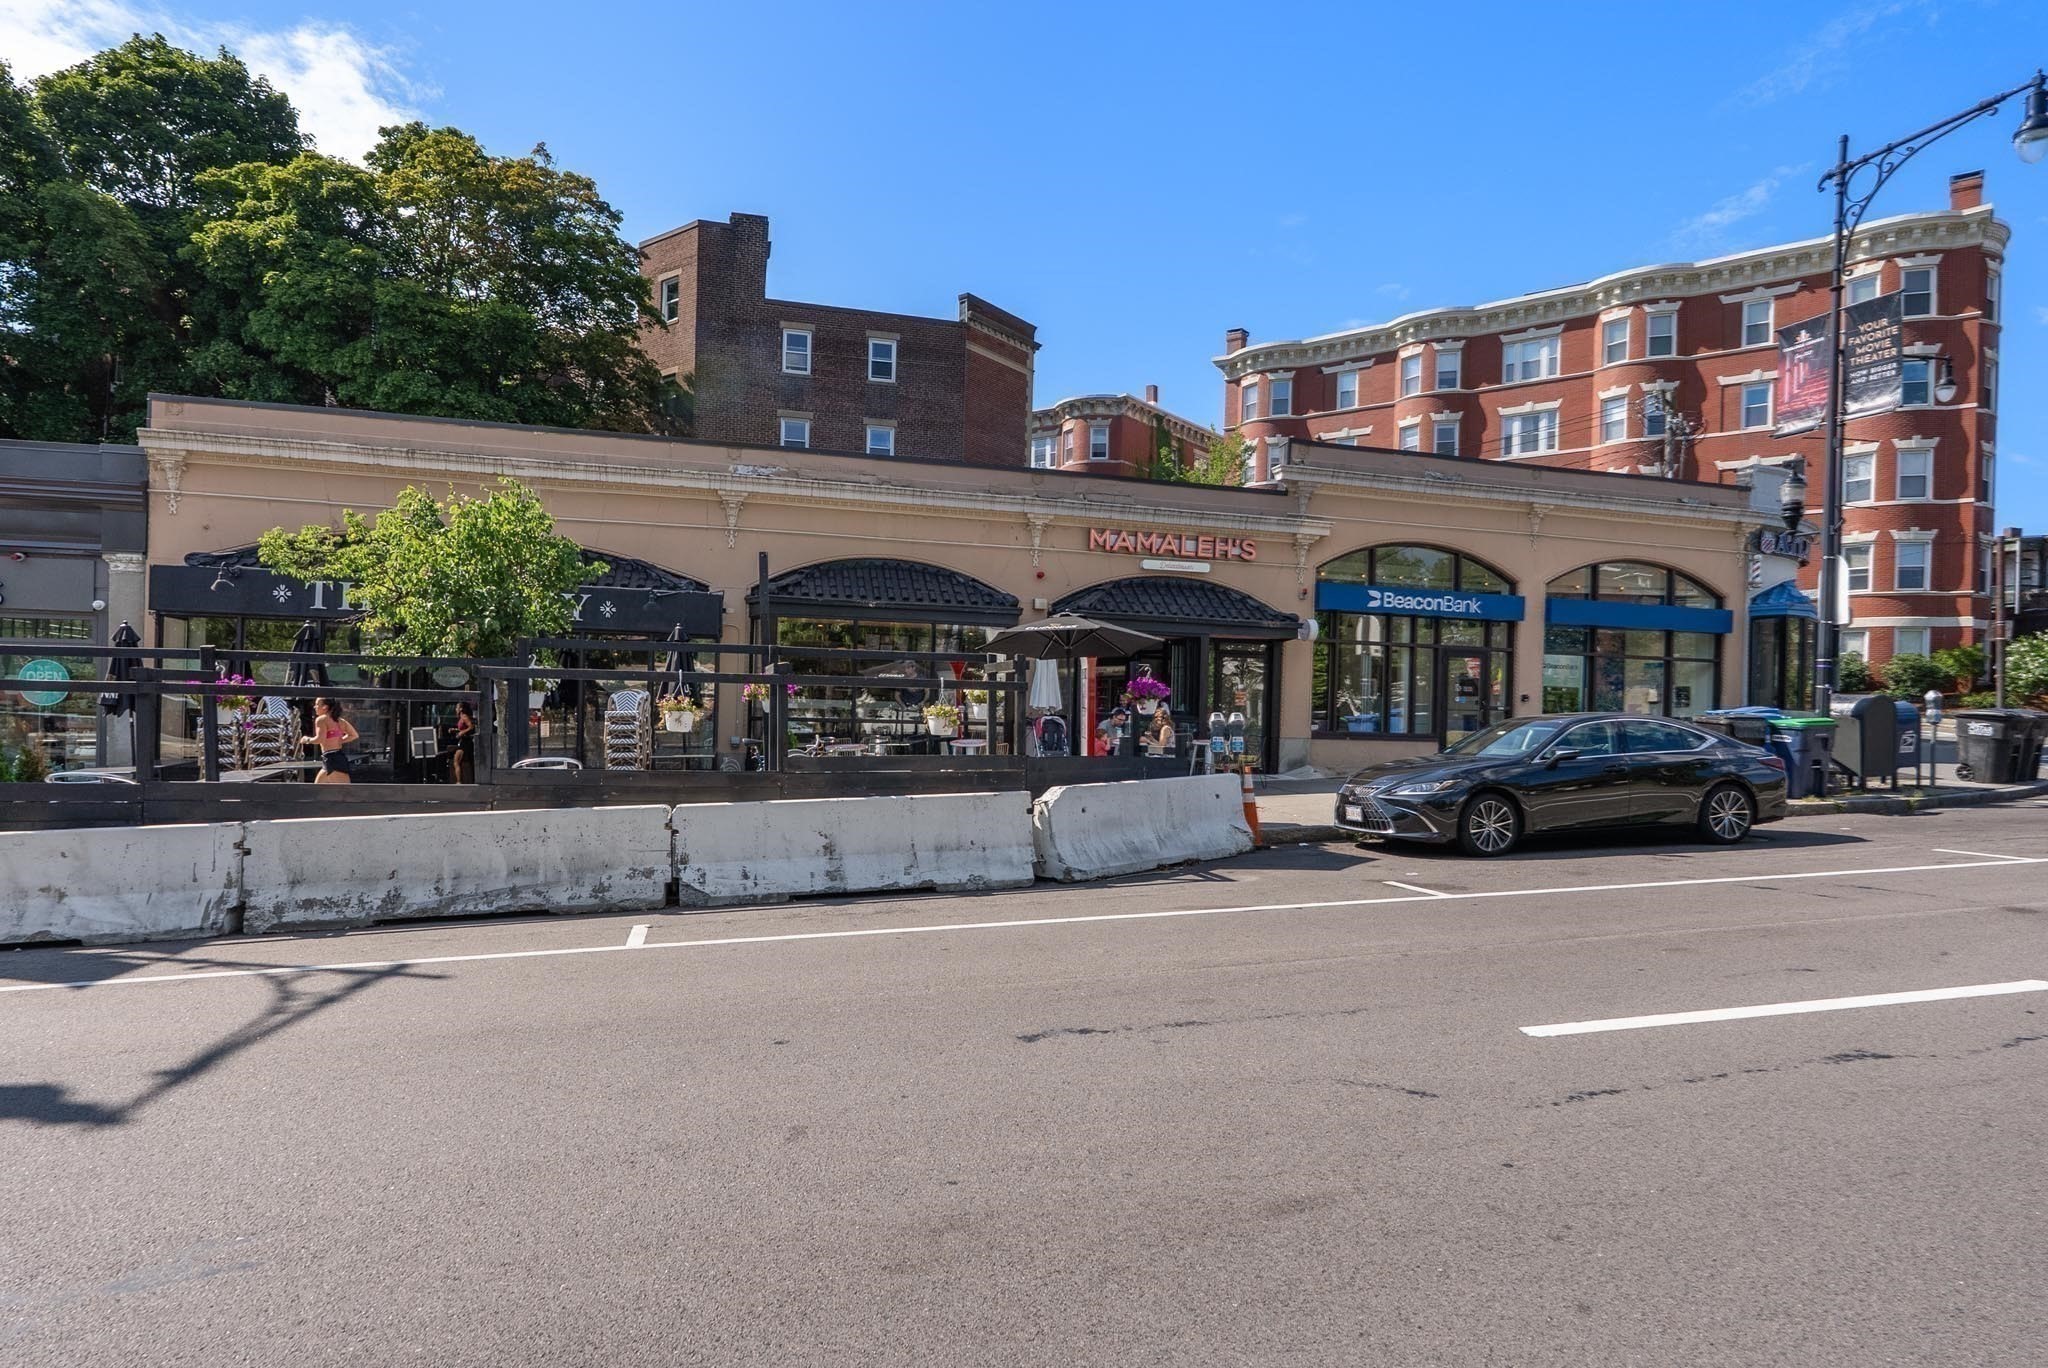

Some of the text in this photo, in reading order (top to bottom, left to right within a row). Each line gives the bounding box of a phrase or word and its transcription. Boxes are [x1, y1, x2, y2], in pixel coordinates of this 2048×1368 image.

[1858, 318, 1888, 333] YOUR
[1848, 325, 1899, 346] FAVORITE
[1855, 338, 1892, 355] MOVIE
[1849, 348, 1897, 366] THEATER
[1850, 362, 1897, 378] NOW BIGGER
[1850, 376, 1867, 384] AND
[1088, 527, 1257, 561] MAMALEH'S
[1383, 591, 1482, 614] BeaconBank
[26, 670, 63, 681] OPEN
